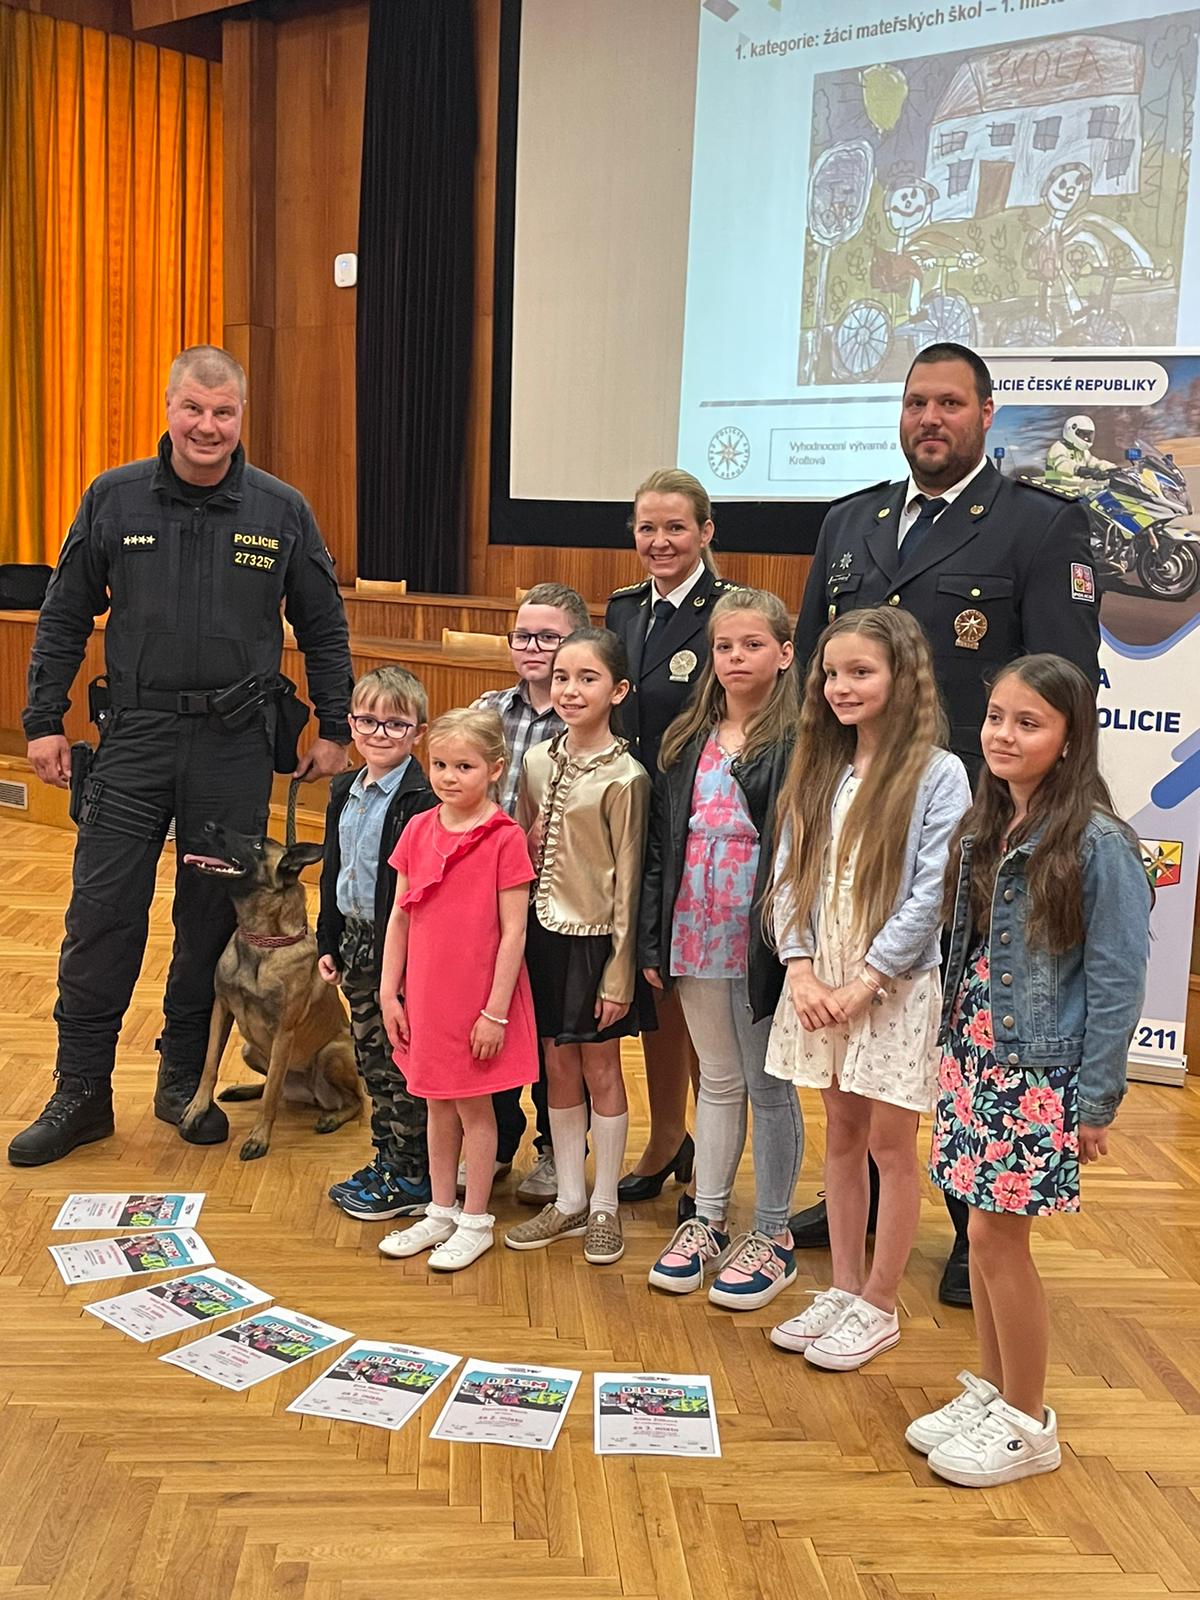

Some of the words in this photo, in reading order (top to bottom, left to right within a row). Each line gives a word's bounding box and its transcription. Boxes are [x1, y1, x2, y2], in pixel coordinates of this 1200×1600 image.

[735, 44, 747, 60] 1.
[750, 33, 820, 58] kategorie:
[823, 25, 853, 46] žáci
[856, 9, 945, 40] mateřských
[948, 1, 983, 23] škol
[991, 379, 1025, 391] LICIE
[1027, 376, 1072, 391] ČESKÉ
[1075, 379, 1157, 391] REPUBLIKY
[789, 441, 847, 453] Vyhodnocení
[234, 533, 280, 550] POLICIE
[234, 551, 275, 569] 273257
[1097, 707, 1181, 733] OLICIE
